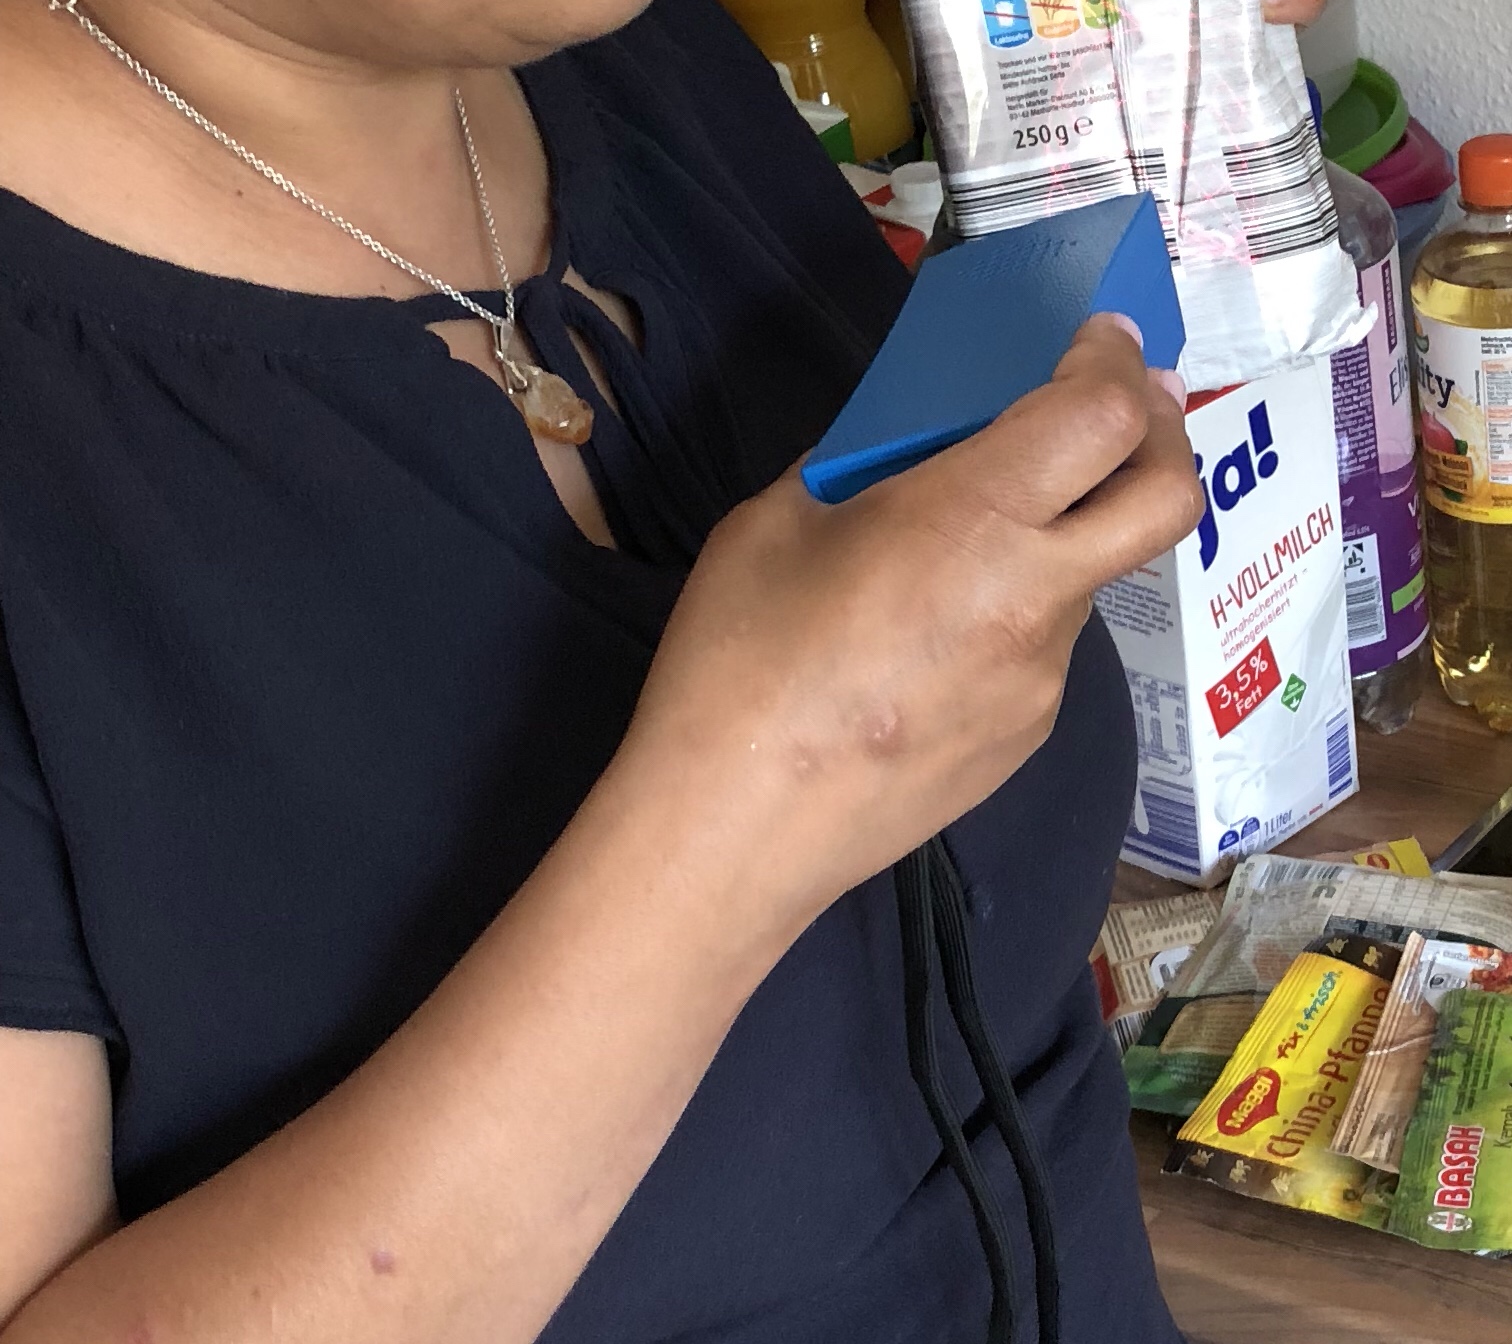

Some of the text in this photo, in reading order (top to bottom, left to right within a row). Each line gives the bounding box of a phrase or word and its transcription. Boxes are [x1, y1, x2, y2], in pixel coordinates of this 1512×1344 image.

[1013, 124, 1070, 149] 250 g
[1193, 399, 1279, 573] ja!
[1209, 502, 1335, 630] H-VOLLMILCH
[1220, 573, 1299, 648] ultrahocherhitzt
[1222, 597, 1292, 663] homogenisiert
[1215, 647, 1269, 710] 3,5%
[1234, 684, 1263, 718] Fett
[1270, 809, 1293, 834] Liter
[1277, 1030, 1304, 1060] fix
[1303, 970, 1343, 1022] frisch
[1224, 1075, 1274, 1131] Maggi
